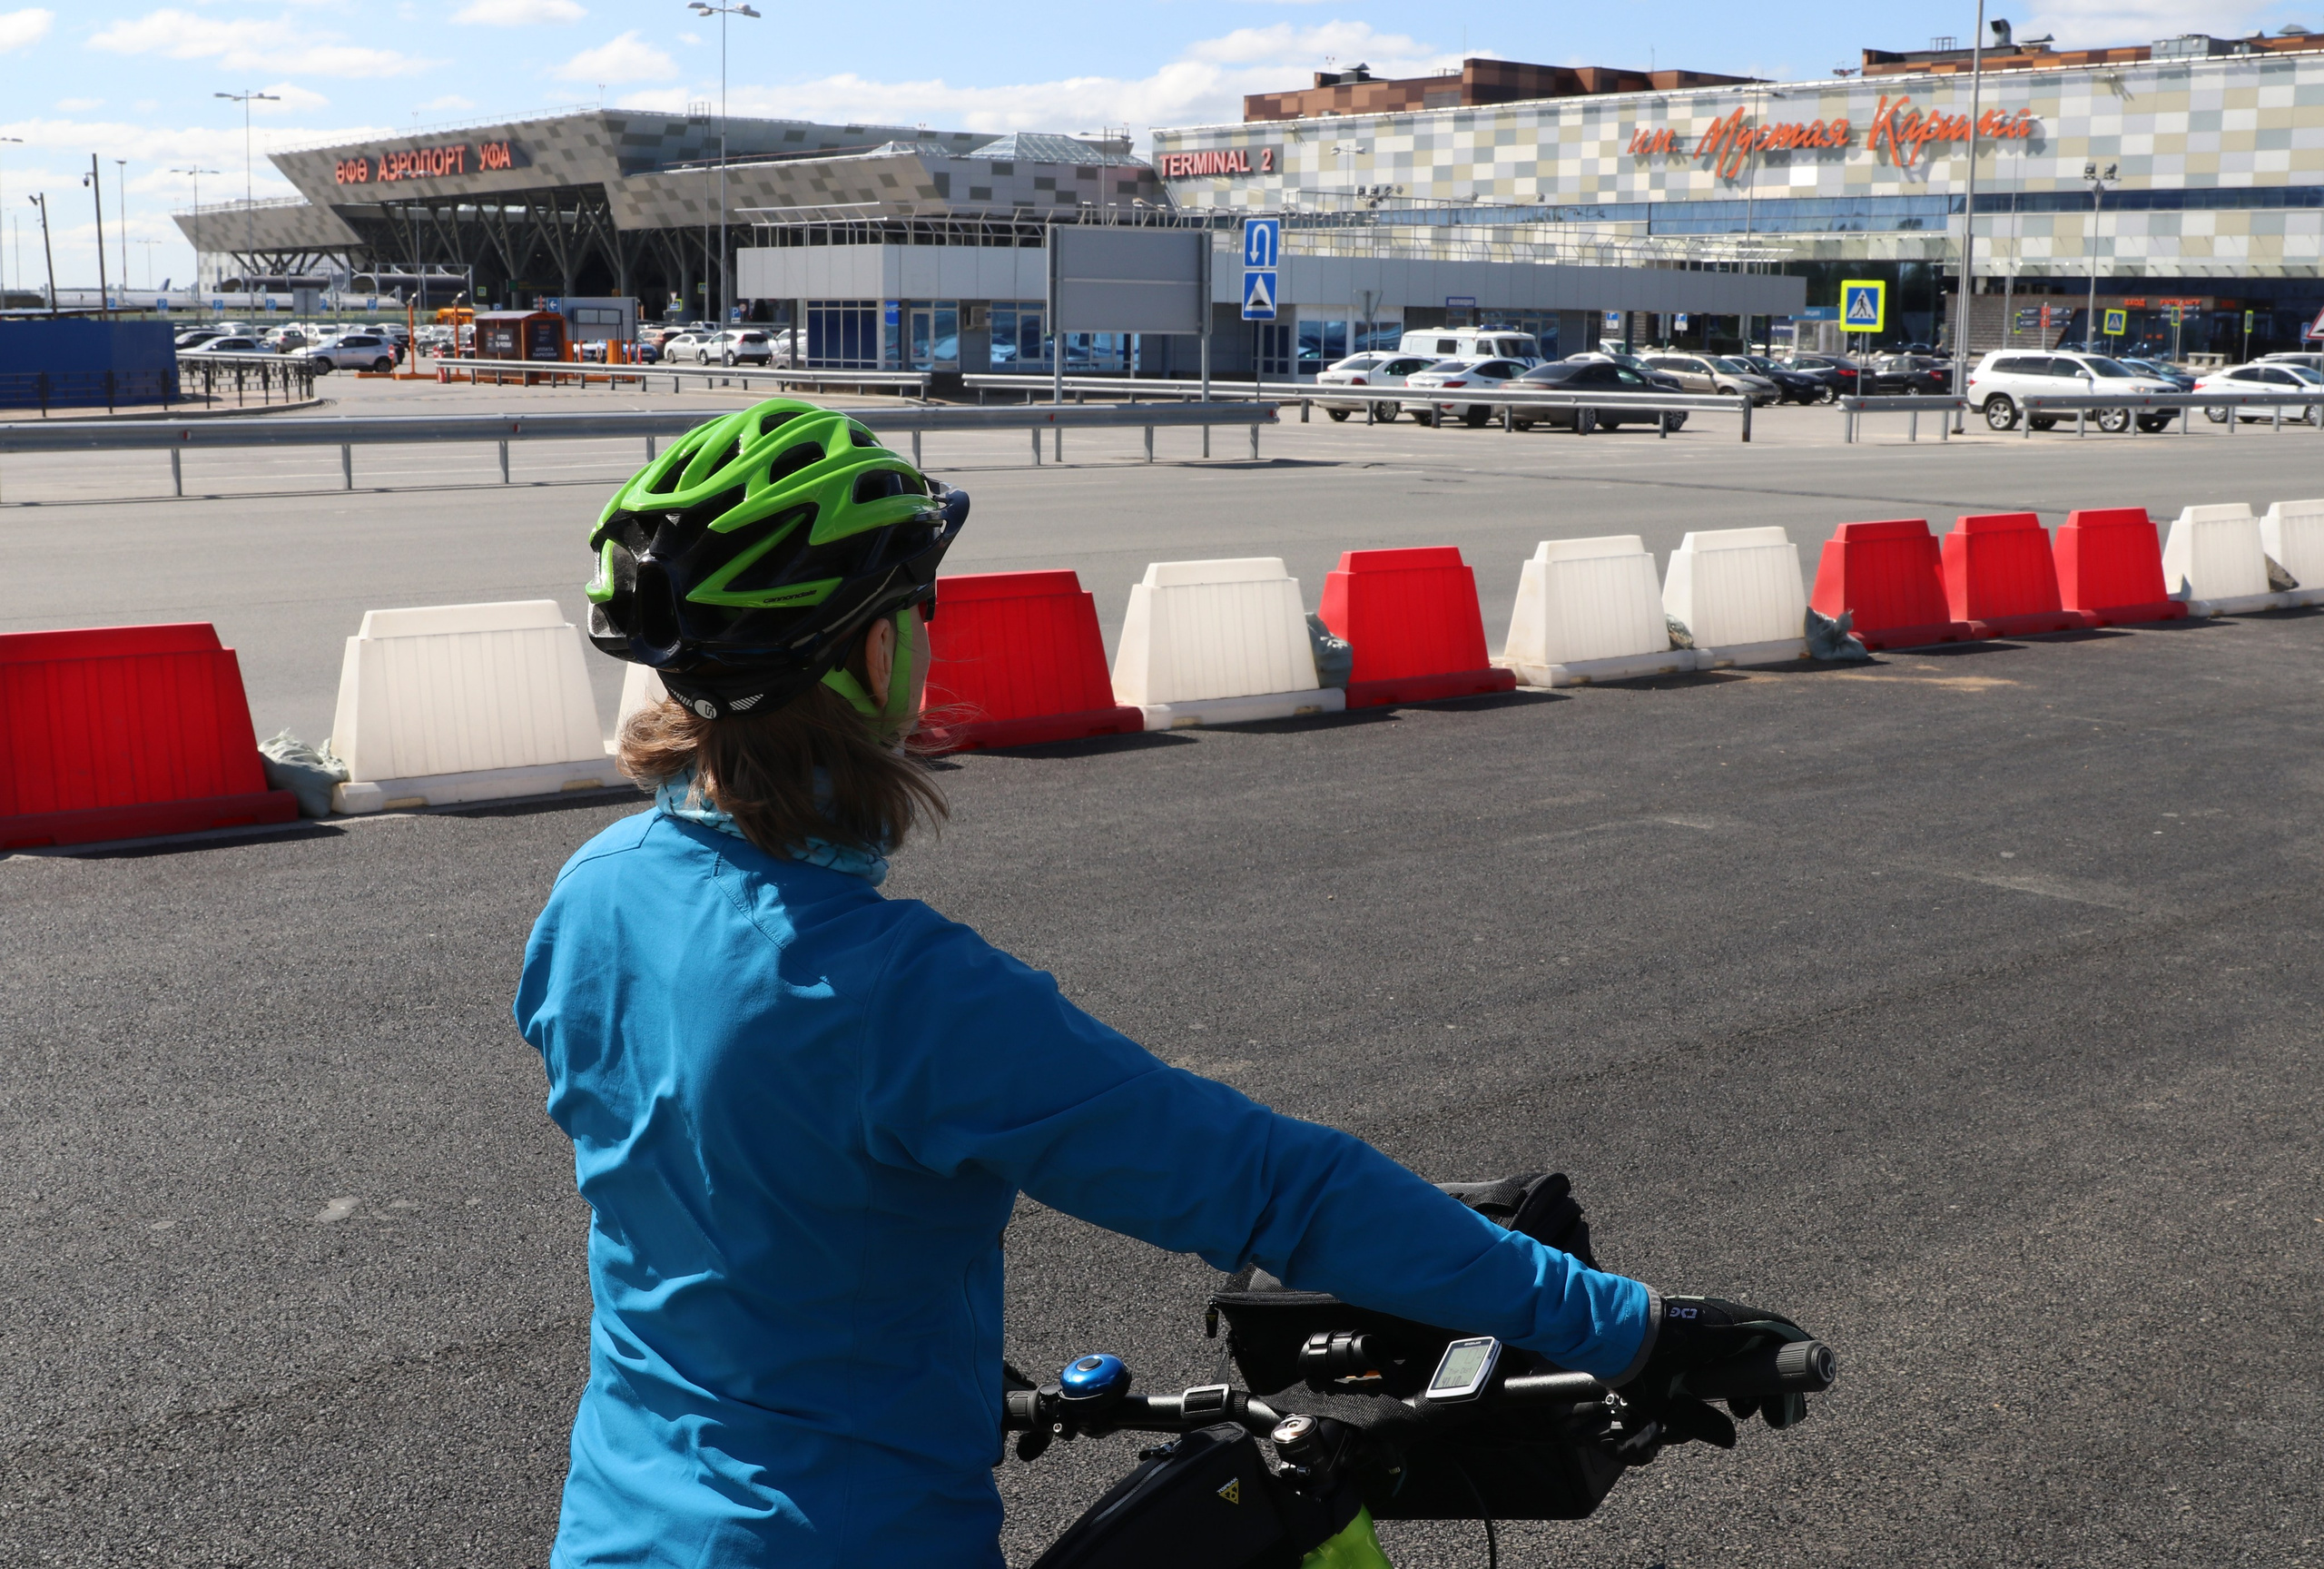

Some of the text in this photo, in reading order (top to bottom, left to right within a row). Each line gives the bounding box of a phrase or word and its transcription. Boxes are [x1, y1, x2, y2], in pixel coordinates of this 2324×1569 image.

[1627, 127, 1678, 154] им.
[1693, 106, 1850, 179] Мустая
[378, 144, 466, 182] АЭРОПОРТ
[478, 141, 511, 171] УФА
[1159, 148, 1274, 176] TERMINAL 2
[763, 588, 817, 604] cannondale
[1216, 1476, 1239, 1494] TOPEAK
